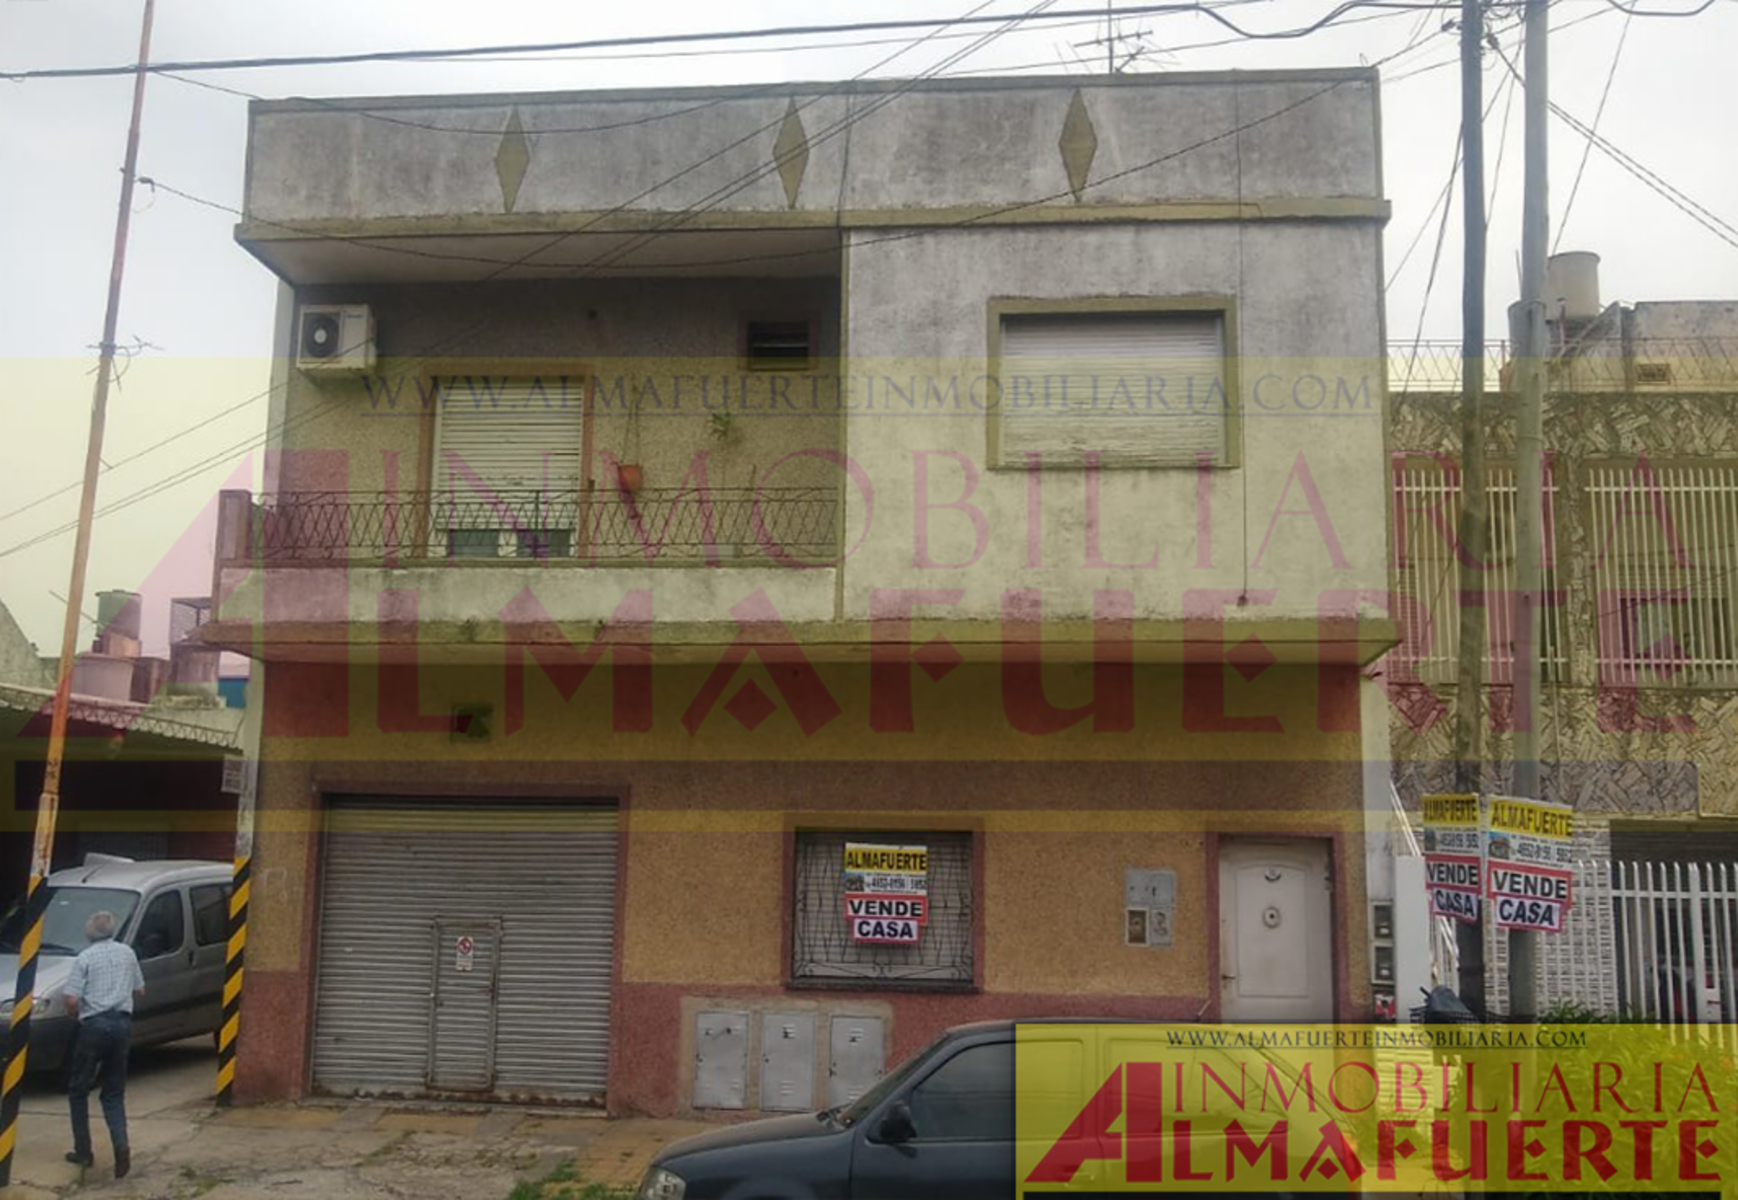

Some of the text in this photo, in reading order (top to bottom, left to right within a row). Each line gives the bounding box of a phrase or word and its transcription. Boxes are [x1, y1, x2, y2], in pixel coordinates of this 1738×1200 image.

[1491, 802, 1572, 836] ALMAFUERTE
[846, 851, 926, 870] ALMAFUERTE
[1427, 863, 1479, 885] VENDE
[1493, 870, 1567, 899] VENDE
[848, 900, 922, 916] VENDE
[1435, 890, 1475, 917] CASA
[1499, 899, 1555, 926] CASA
[857, 920, 914, 938] CASA
